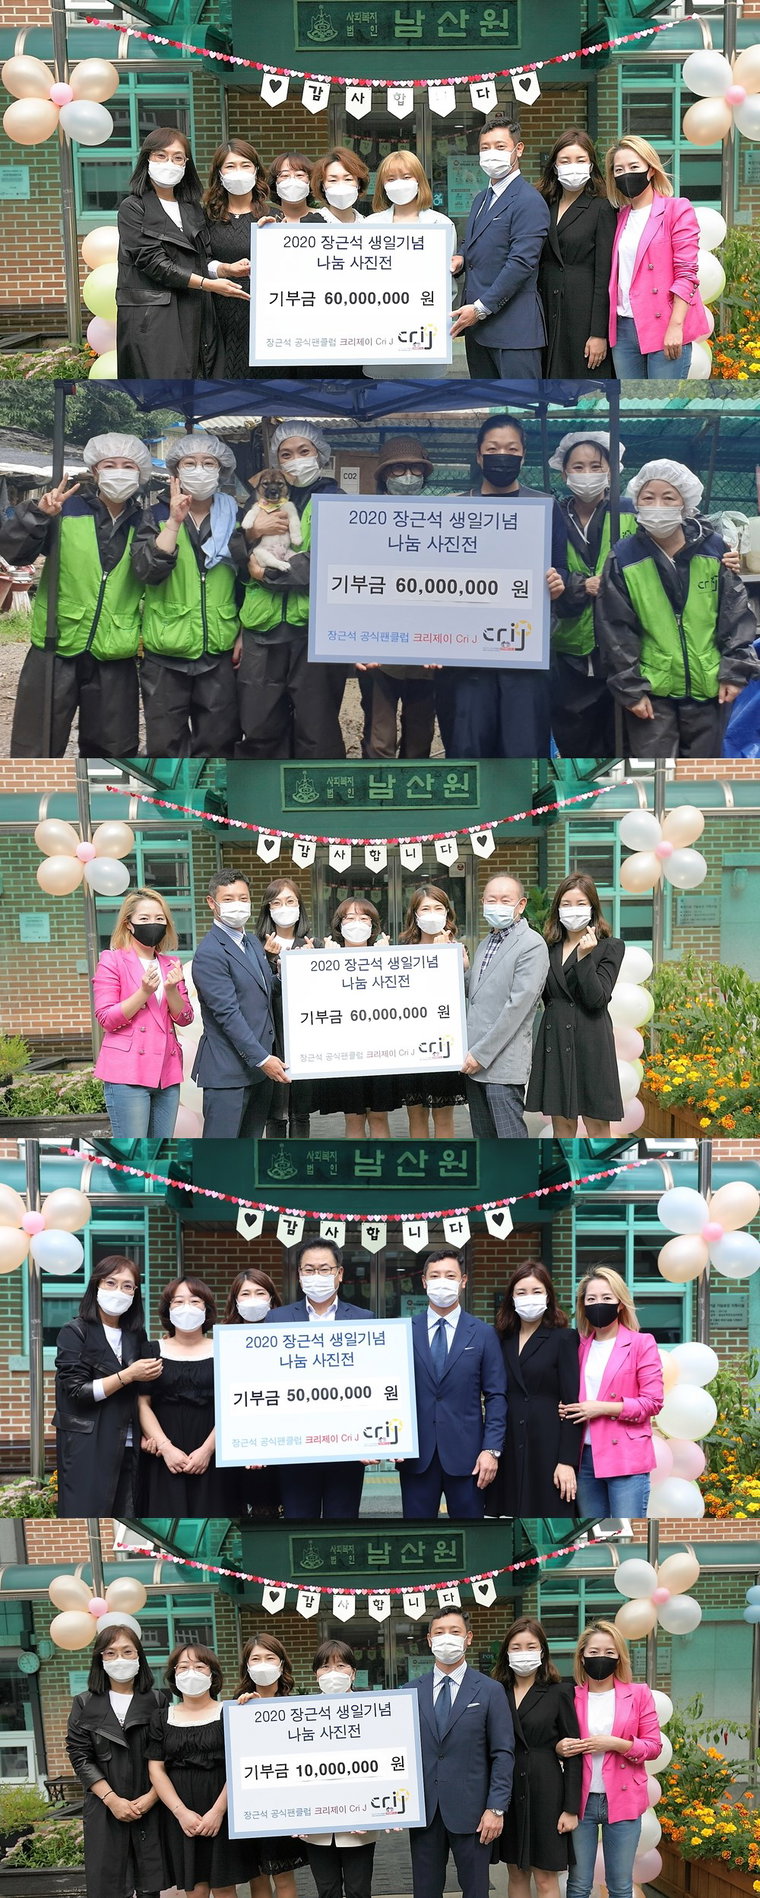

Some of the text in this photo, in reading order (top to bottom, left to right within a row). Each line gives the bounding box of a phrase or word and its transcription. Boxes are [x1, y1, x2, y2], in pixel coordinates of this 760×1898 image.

[346, 12, 378, 24] 사회복지
[394, 9, 509, 38] 남산원
[309, 85, 490, 106] 감사합다
[283, 235, 424, 250] 2020 장근석 생일기념
[317, 255, 392, 270] 나눔 사진전
[269, 291, 434, 306] 기부금 60,000,000 원
[266, 338, 291, 347] 장근석
[340, 338, 372, 346] 크리제이
[350, 511, 518, 530] 2020 장근석 생일기념
[388, 535, 477, 553] 나눔 사진전
[331, 575, 528, 598] 기부금 60,000,000 원
[328, 631, 477, 643] 장근석 공식팬클럽 크리제이 Cri J
[369, 773, 469, 799] 남산원
[311, 955, 438, 971] 2020 장근석 생일기념
[342, 974, 410, 990] 나눔 사진전
[300, 1004, 450, 1025] 기부금 60,000,000 원
[367, 1050, 396, 1058] 크리제이
[306, 1151, 337, 1162] 사회복지
[354, 1150, 467, 1177] 남산원
[246, 1331, 385, 1349] 2020 장근석 생일기념
[280, 1352, 354, 1369] 나눔 사진전
[234, 1385, 398, 1407] 기부금 50,000,000 원
[232, 1439, 257, 1448] 장근석
[305, 1435, 338, 1444] 크리제이
[341, 1434, 352, 1442] Cri
[368, 1540, 456, 1565] 남산원
[255, 1702, 391, 1723] 2020 장근석 생일기념
[288, 1724, 361, 1742] 나눔 사진전
[244, 1756, 404, 1780] 기부금 10,000,000 원
[244, 1811, 268, 1820] 장근석
[271, 1808, 311, 1818] 공식팬클럽
[315, 1806, 346, 1815] 크리제이
[363, 1804, 367, 1812] J
